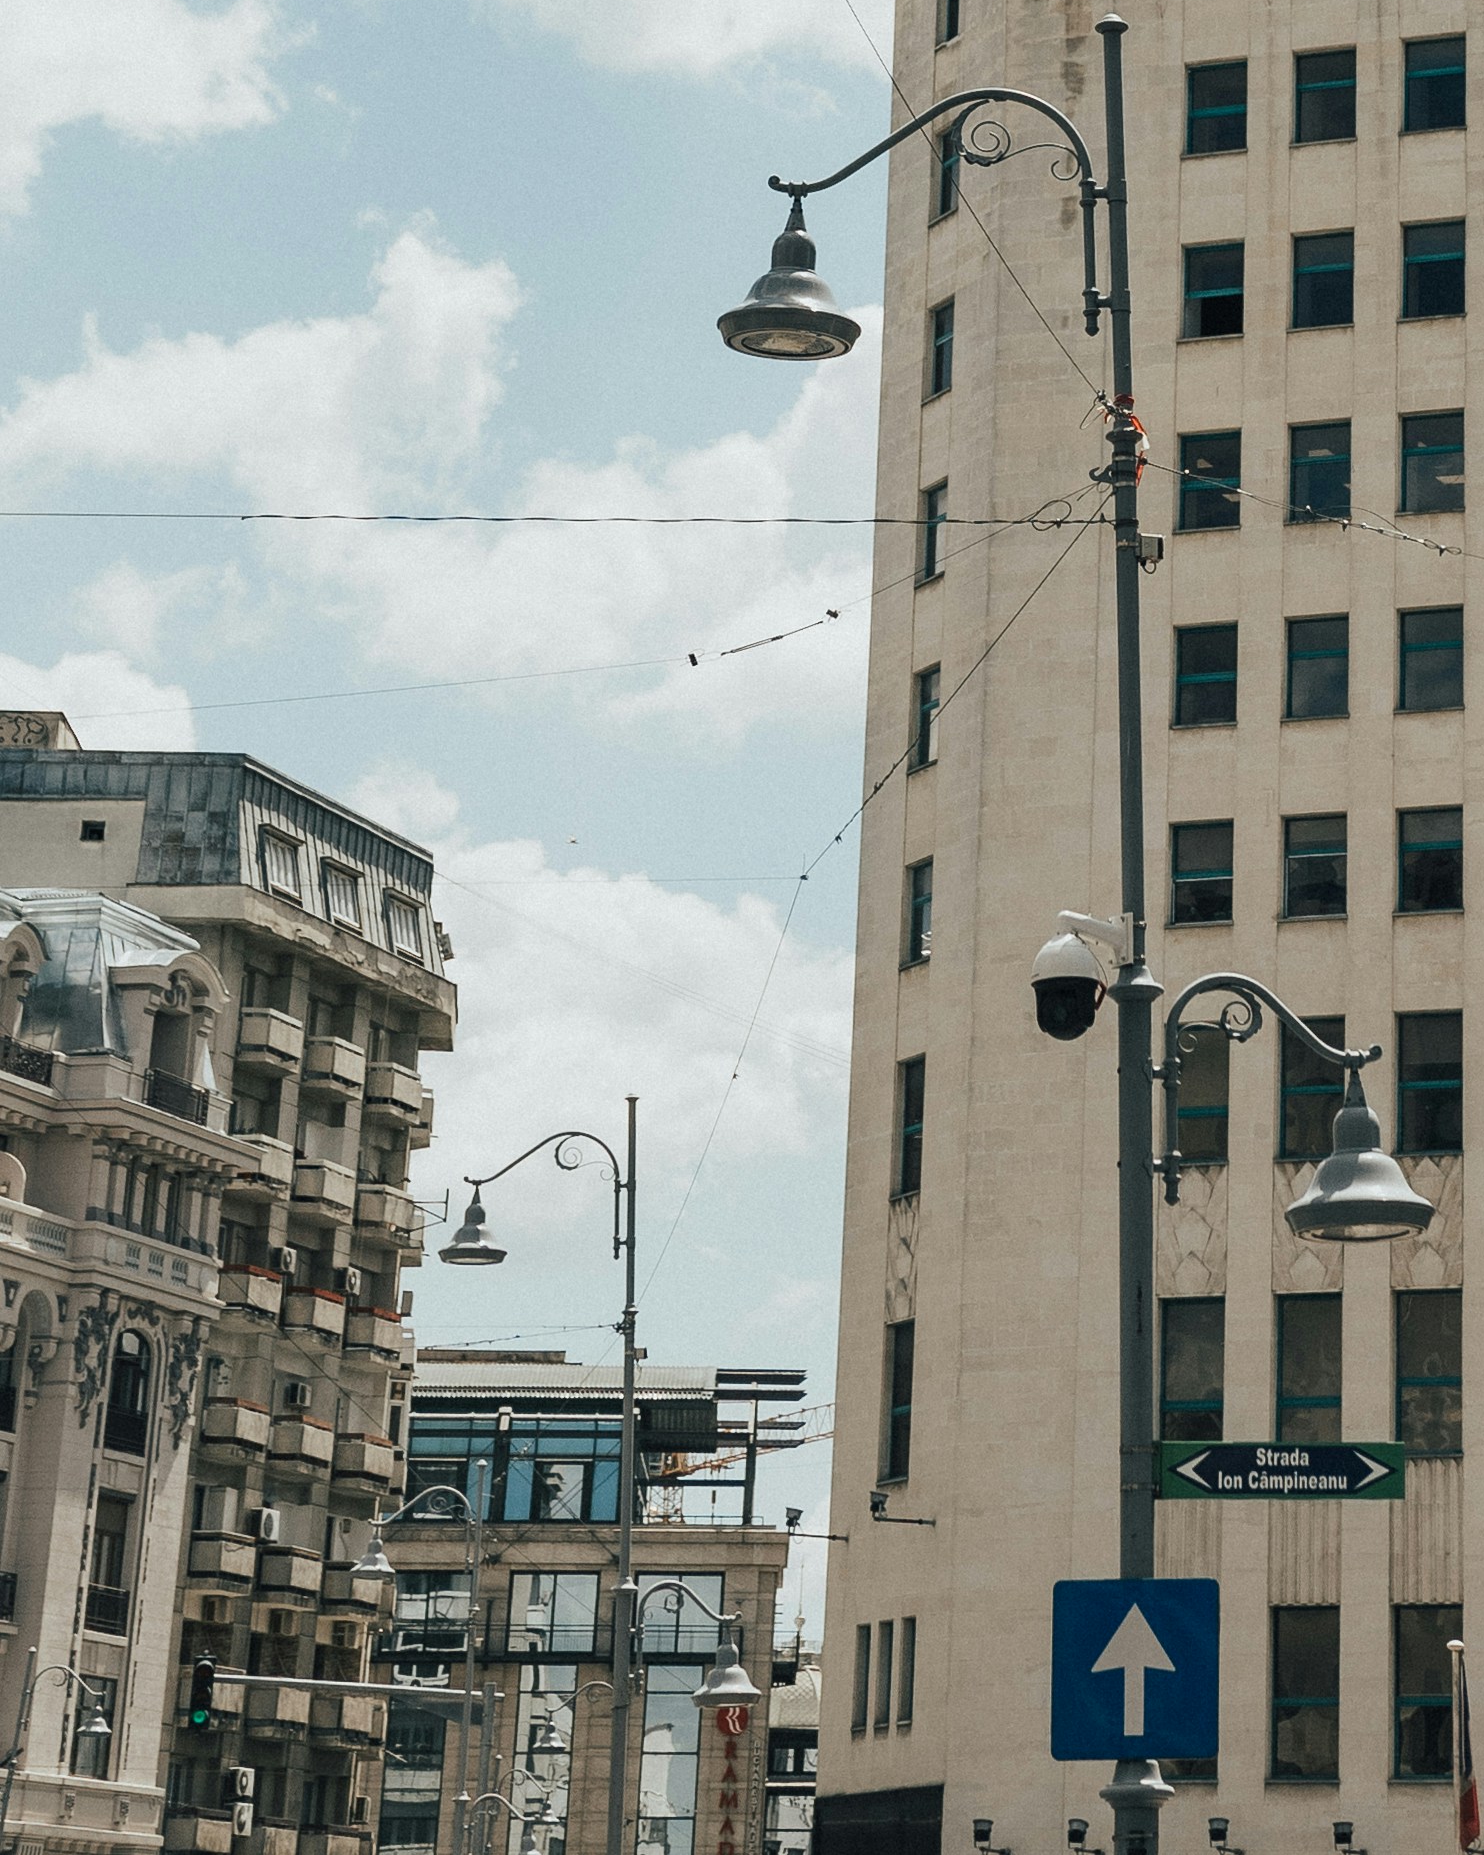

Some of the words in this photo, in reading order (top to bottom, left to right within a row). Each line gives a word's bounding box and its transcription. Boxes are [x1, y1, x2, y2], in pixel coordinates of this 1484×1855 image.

[1256, 1447, 1310, 1466] Strada
[1218, 1470, 1243, 1490] Ion
[1248, 1470, 1348, 1495] Câmpineanu
